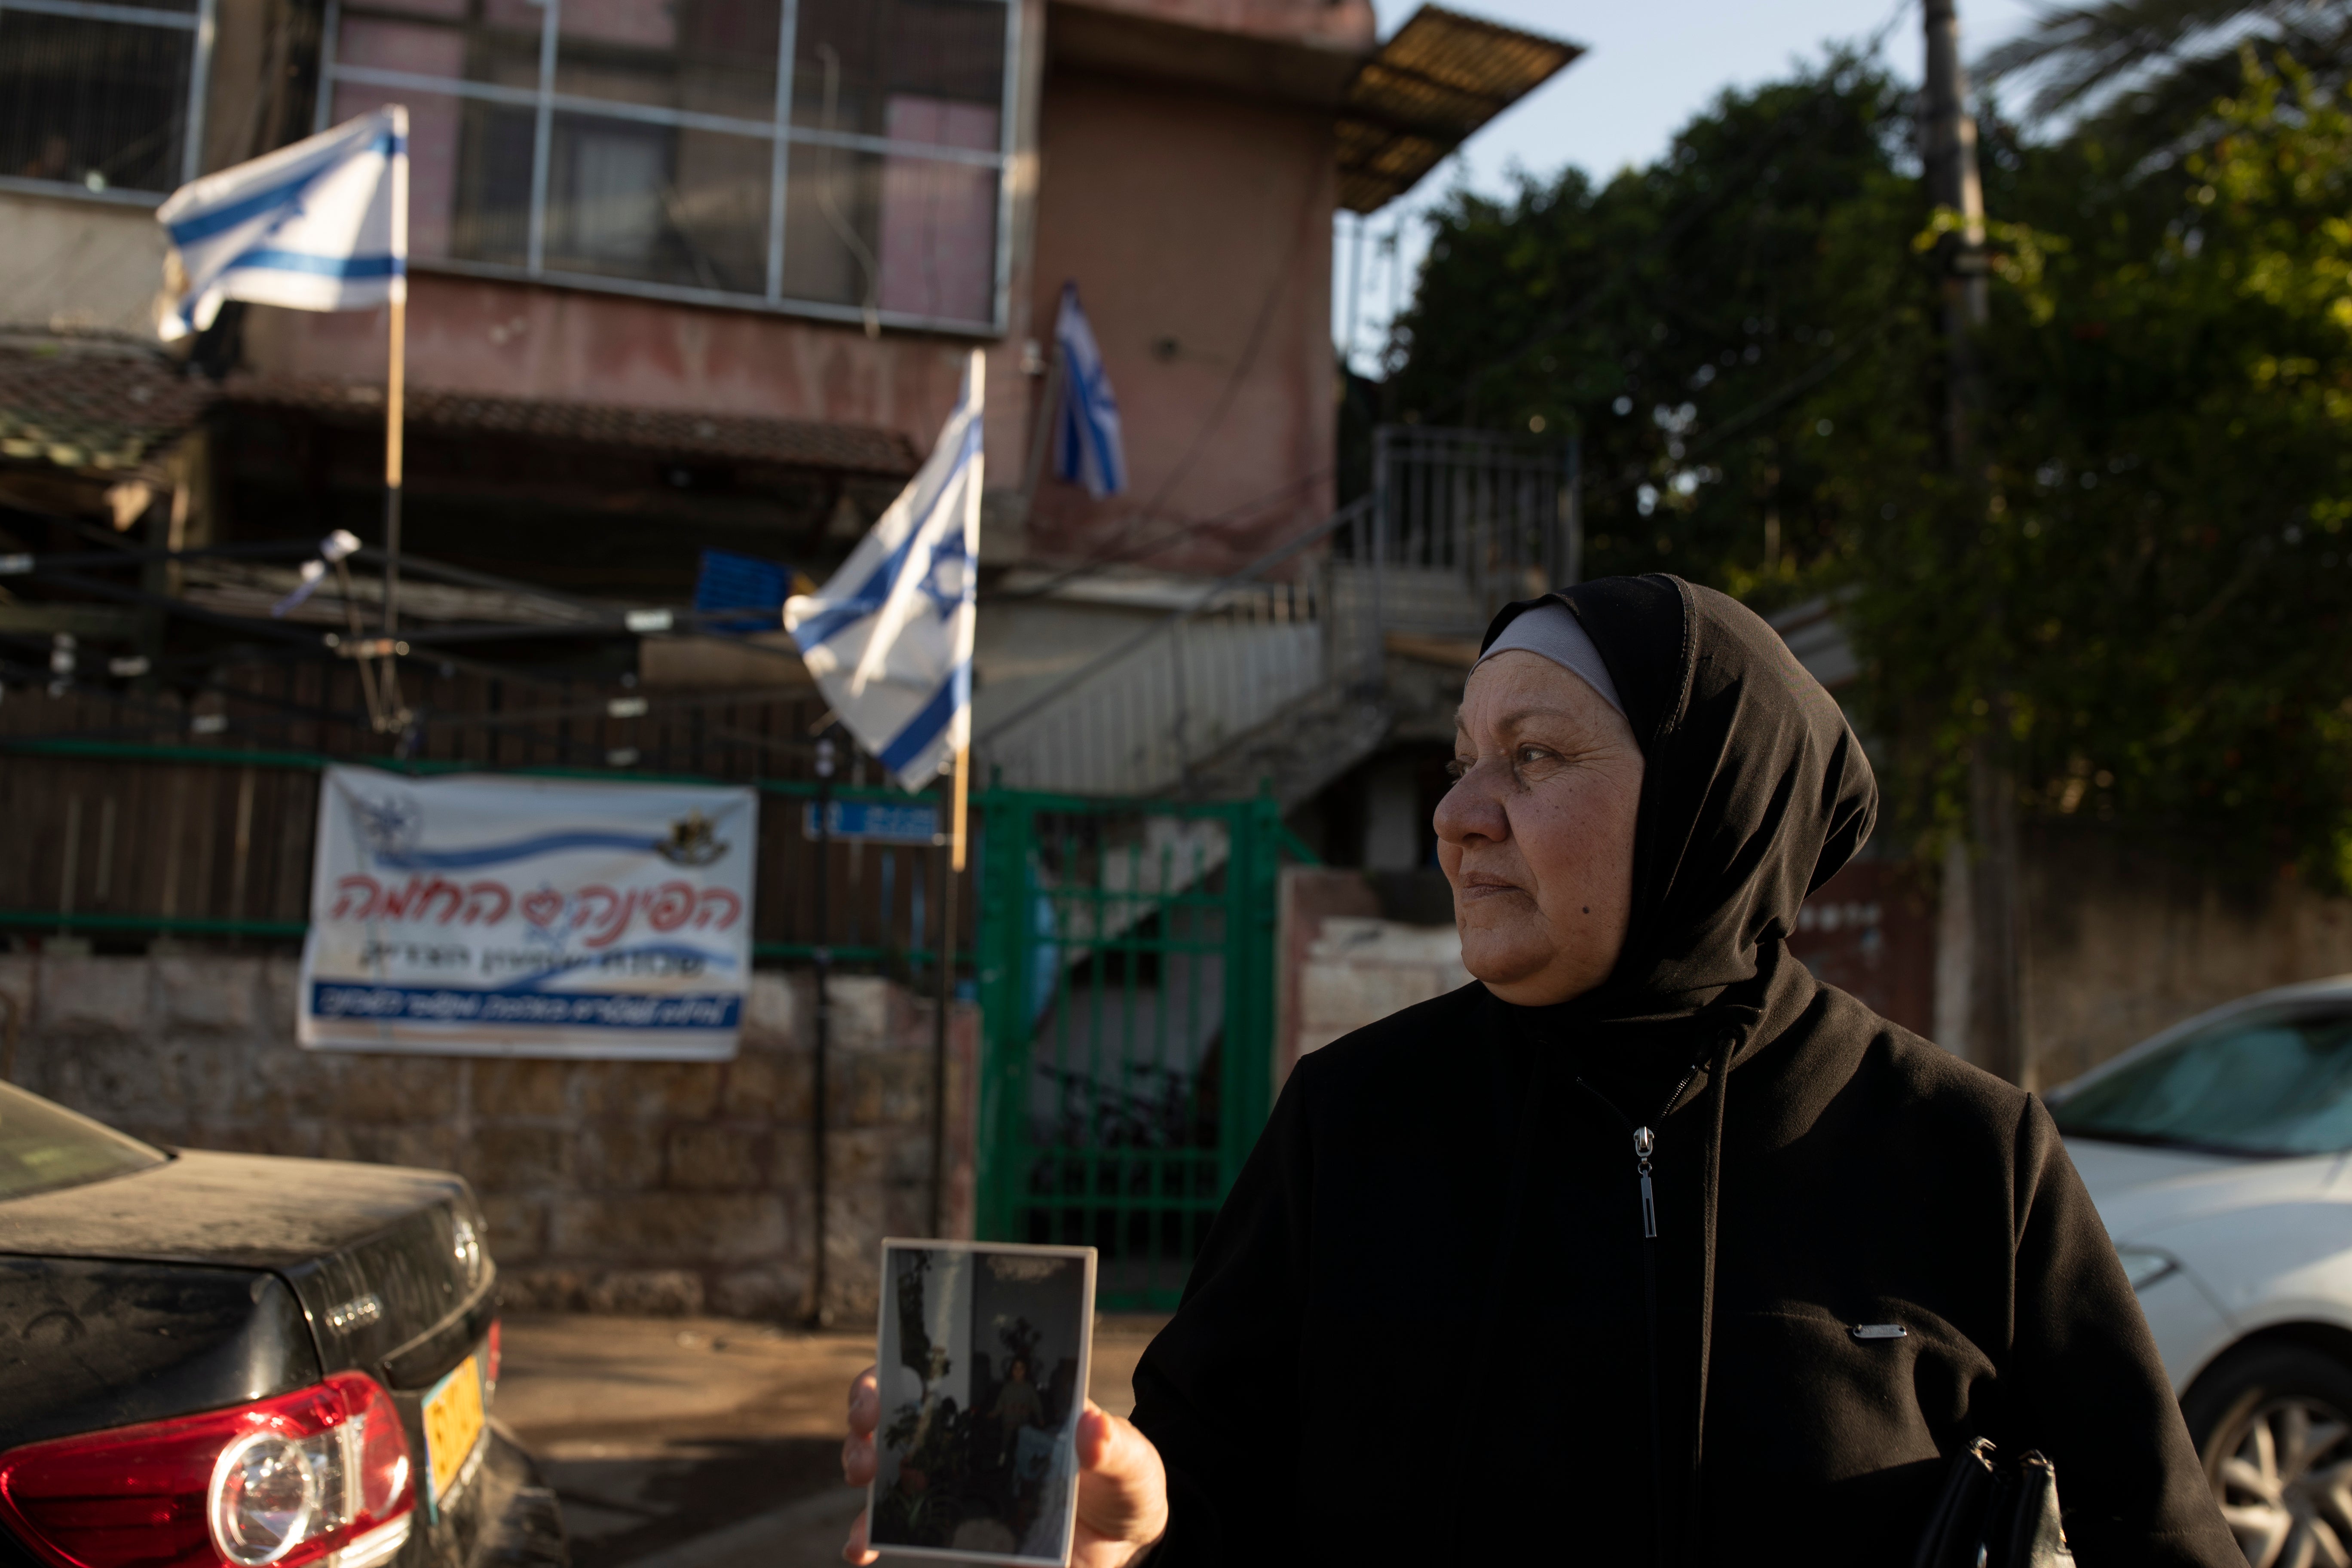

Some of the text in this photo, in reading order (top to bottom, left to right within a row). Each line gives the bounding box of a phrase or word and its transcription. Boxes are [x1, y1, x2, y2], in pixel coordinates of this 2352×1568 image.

[329, 872, 744, 949] הפינה החמה
[359, 943, 471, 970] הצדיק
[480, 947, 589, 975] שמעון
